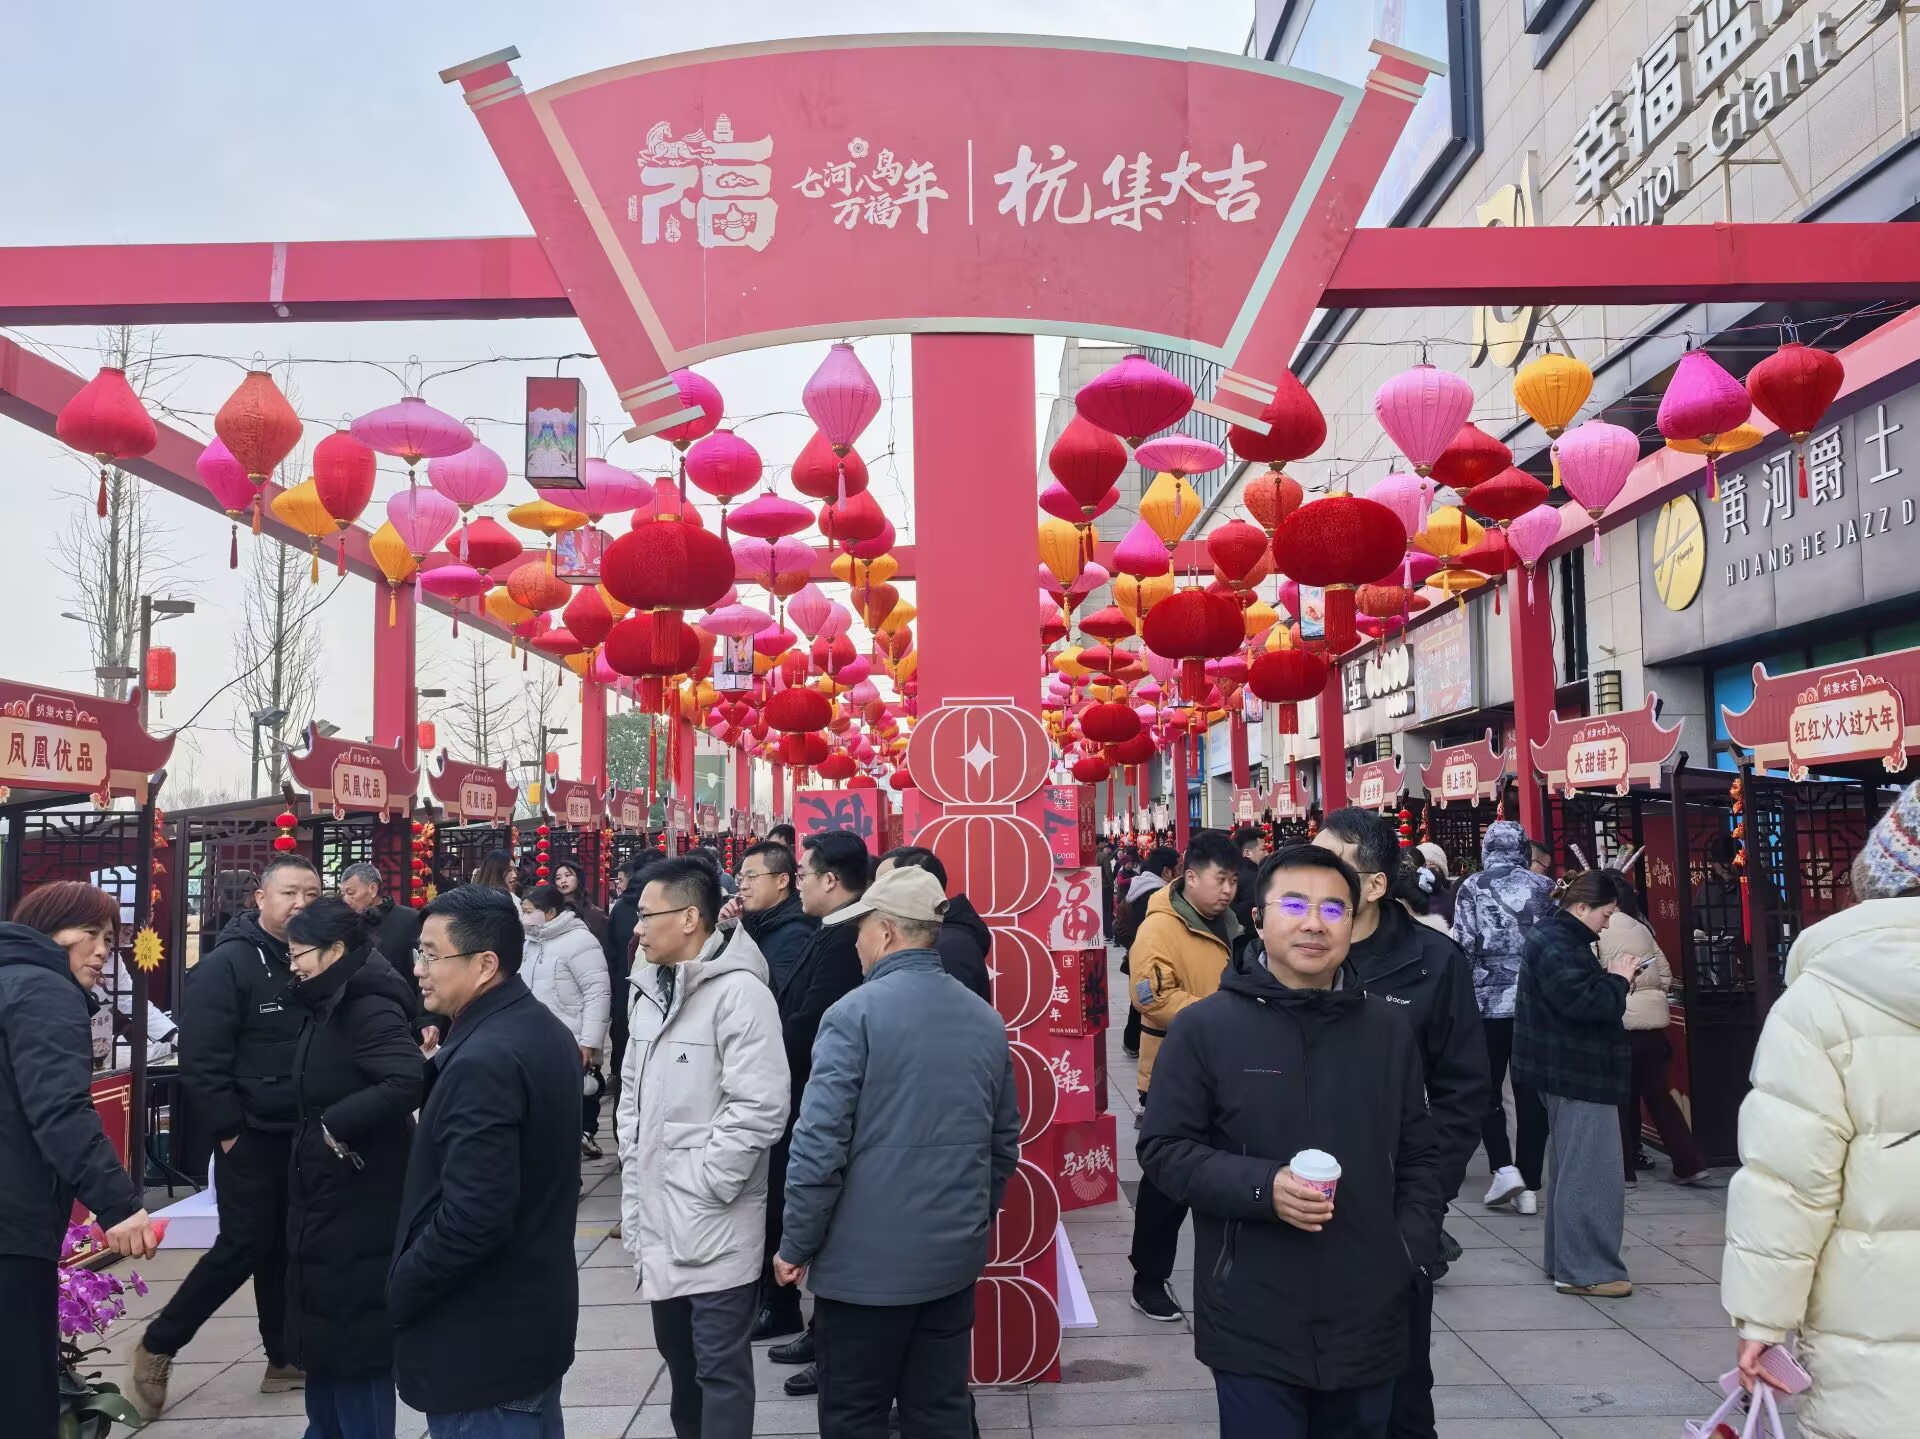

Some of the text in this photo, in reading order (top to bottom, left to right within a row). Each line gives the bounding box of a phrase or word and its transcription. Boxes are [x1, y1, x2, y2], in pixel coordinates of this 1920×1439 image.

[1707, 12, 1841, 157] Giant
[993, 143, 1268, 233] 杭集大吉
[1720, 404, 1904, 544] 黄河爵士
[1725, 542, 1794, 587] HUANG
[1801, 530, 1826, 561] HE
[1833, 506, 1892, 549] JAZZ
[1794, 704, 1895, 744] 红红火火过大年
[6, 732, 94, 772] 凤凰优品
[1574, 747, 1619, 775] 大甜铺子
[342, 772, 381, 799] 凤凰优品
[466, 789, 493, 810] 凤凰优品
[1059, 1144, 1115, 1177] 马上有钱
